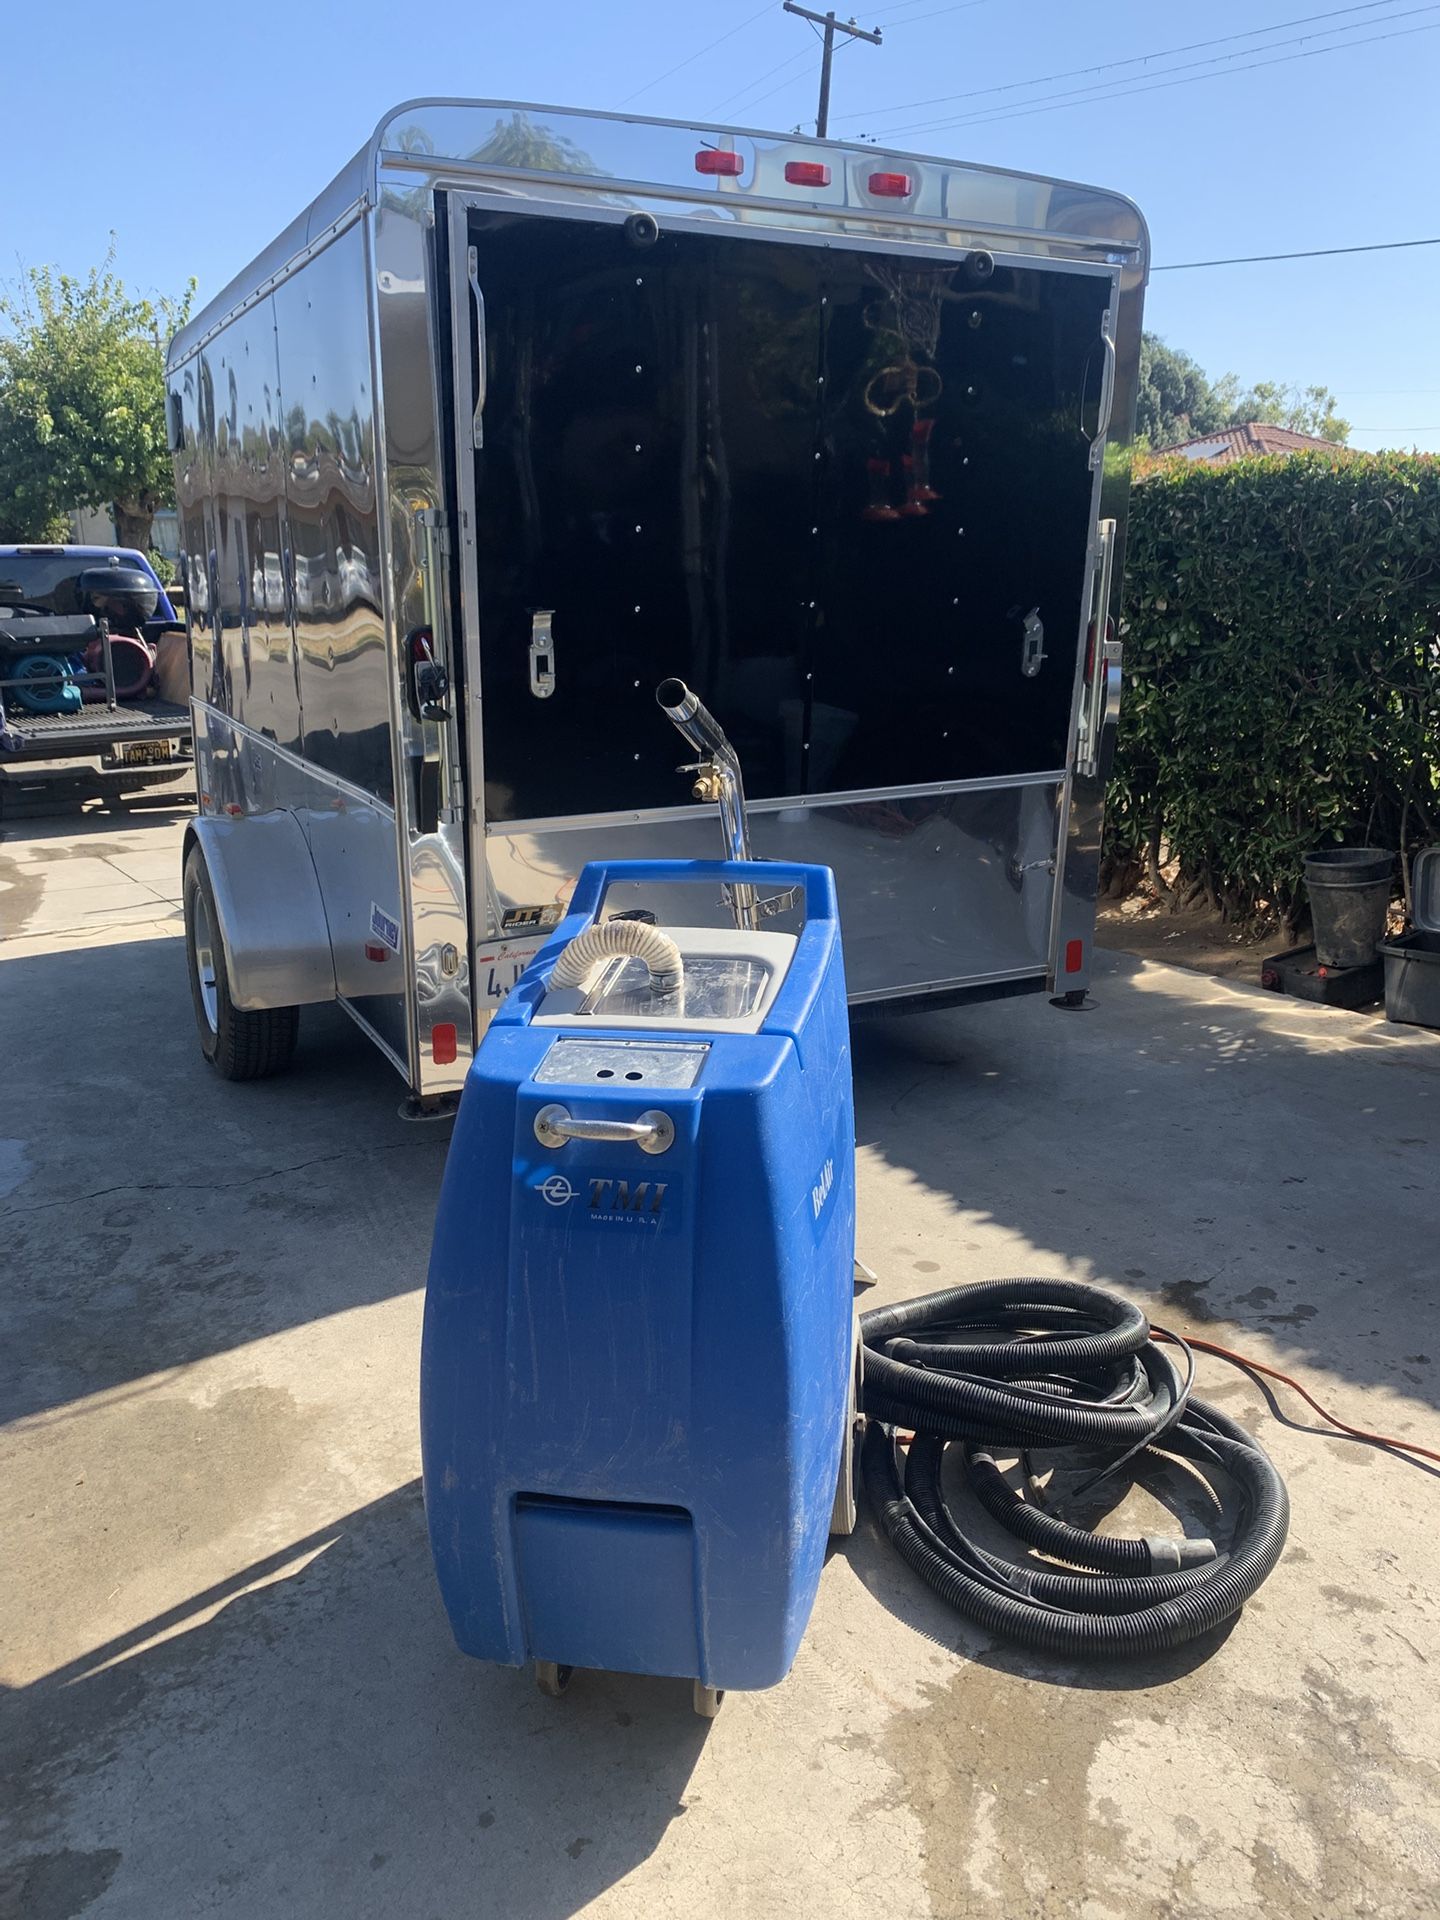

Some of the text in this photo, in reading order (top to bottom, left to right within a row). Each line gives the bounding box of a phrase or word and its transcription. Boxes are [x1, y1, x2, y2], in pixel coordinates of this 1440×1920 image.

[504, 919, 537, 928] RIDER
[498, 948, 537, 961] California
[487, 963, 526, 998] 4J
[587, 1178, 669, 1214] TMI
[590, 1213, 614, 1222] MADE
